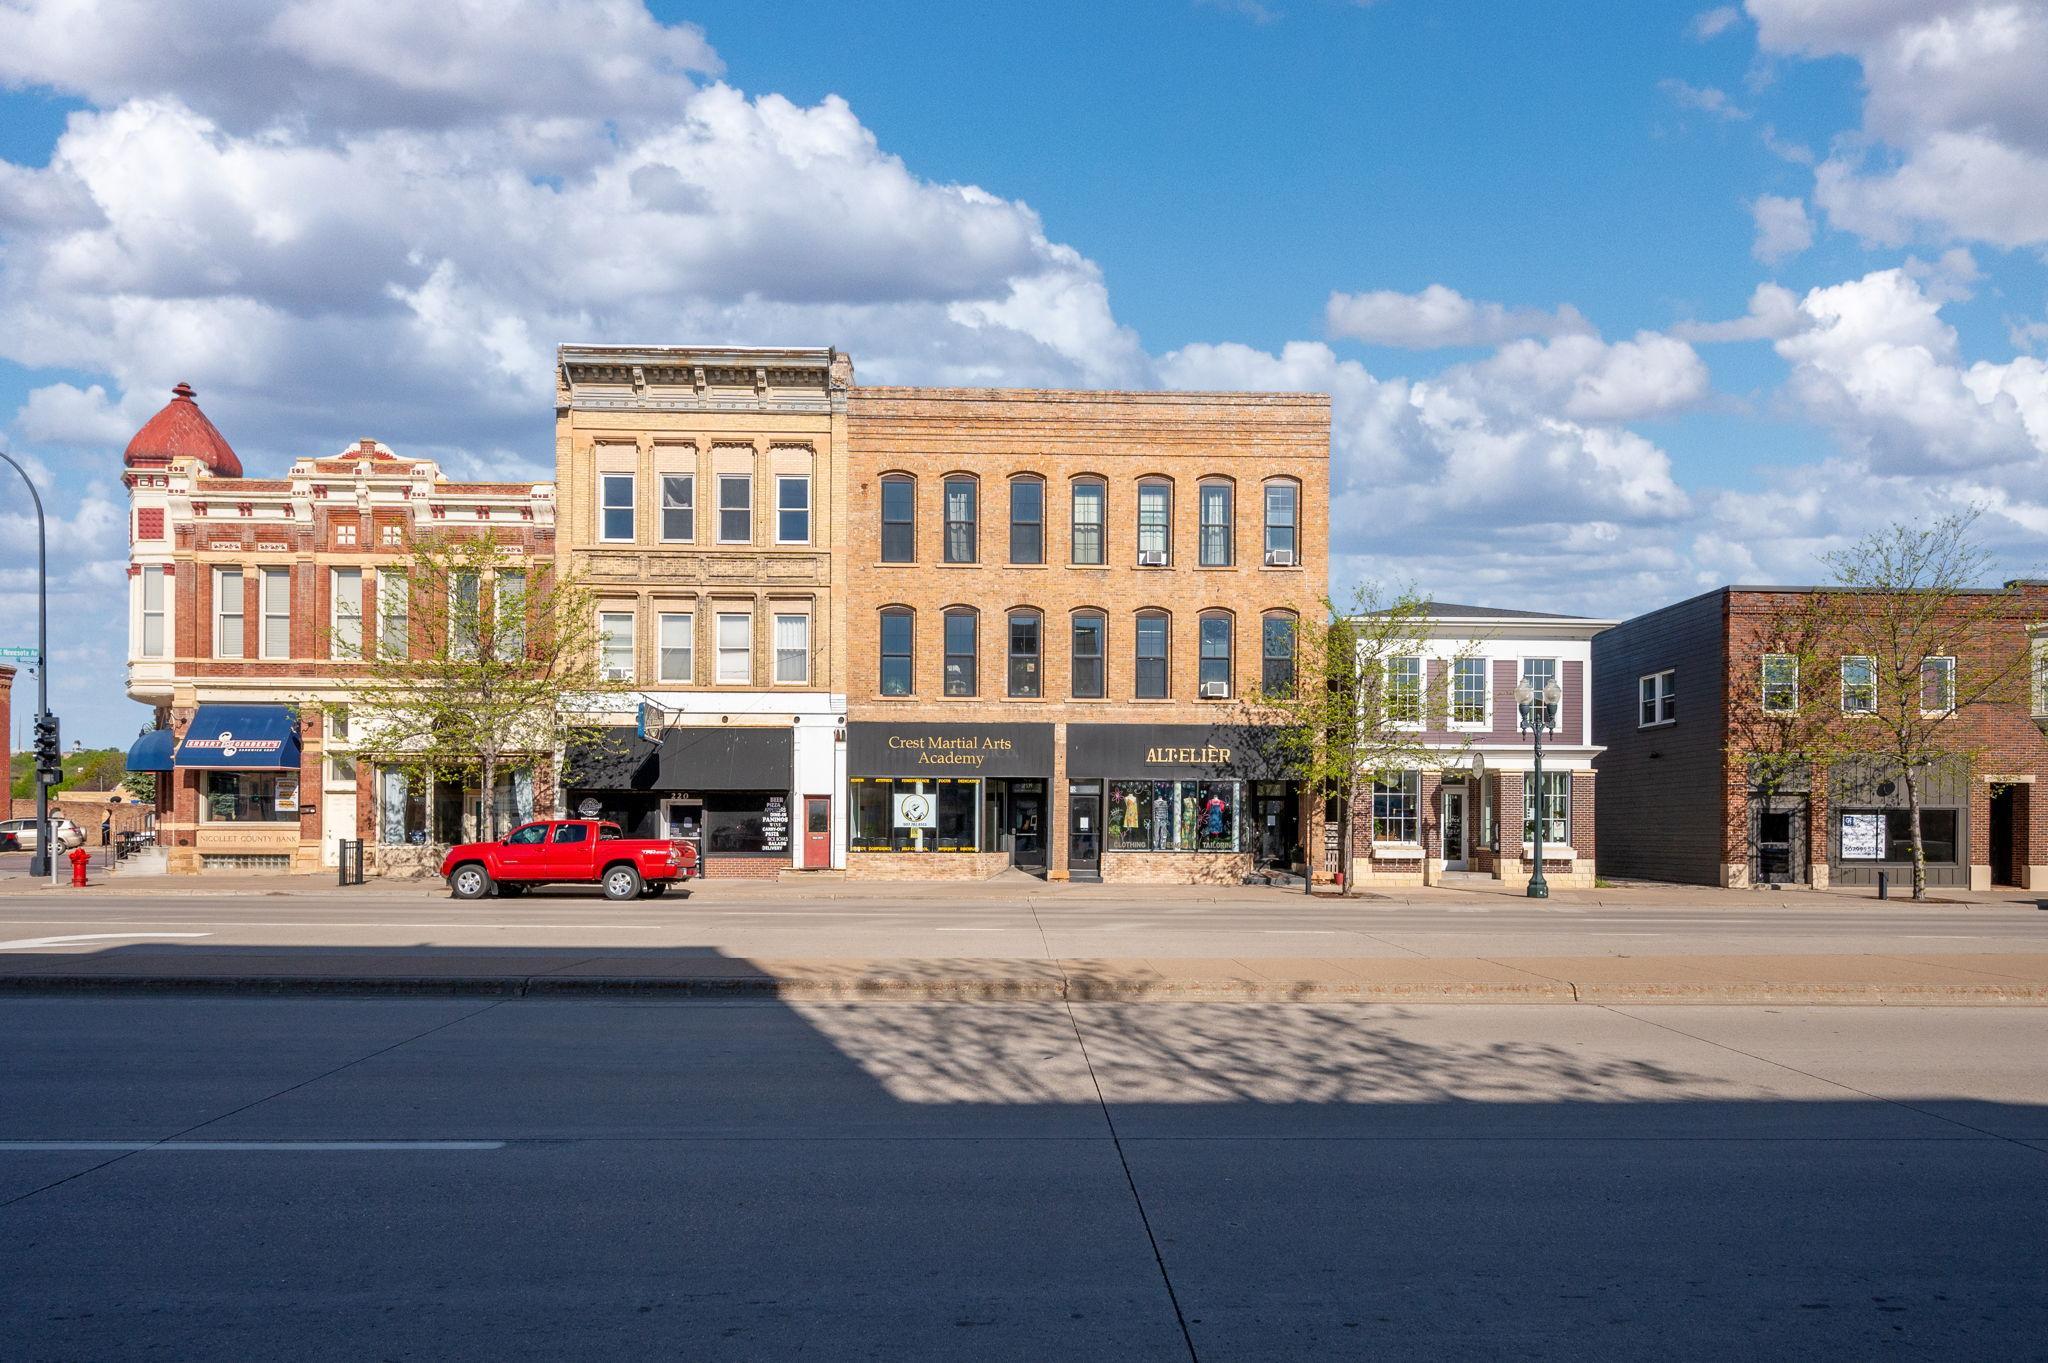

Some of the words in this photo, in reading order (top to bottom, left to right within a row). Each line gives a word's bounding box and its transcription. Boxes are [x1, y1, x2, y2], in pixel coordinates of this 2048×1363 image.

[889, 736, 925, 749] Crest
[928, 736, 978, 749] Martial
[982, 737, 1012, 750] Arts
[918, 751, 985, 768] Academy
[240, 835, 273, 843] COUNTY
[276, 835, 297, 843] BANK
[1113, 841, 1146, 849] CLOTHING
[1202, 841, 1237, 849] TAILORING
